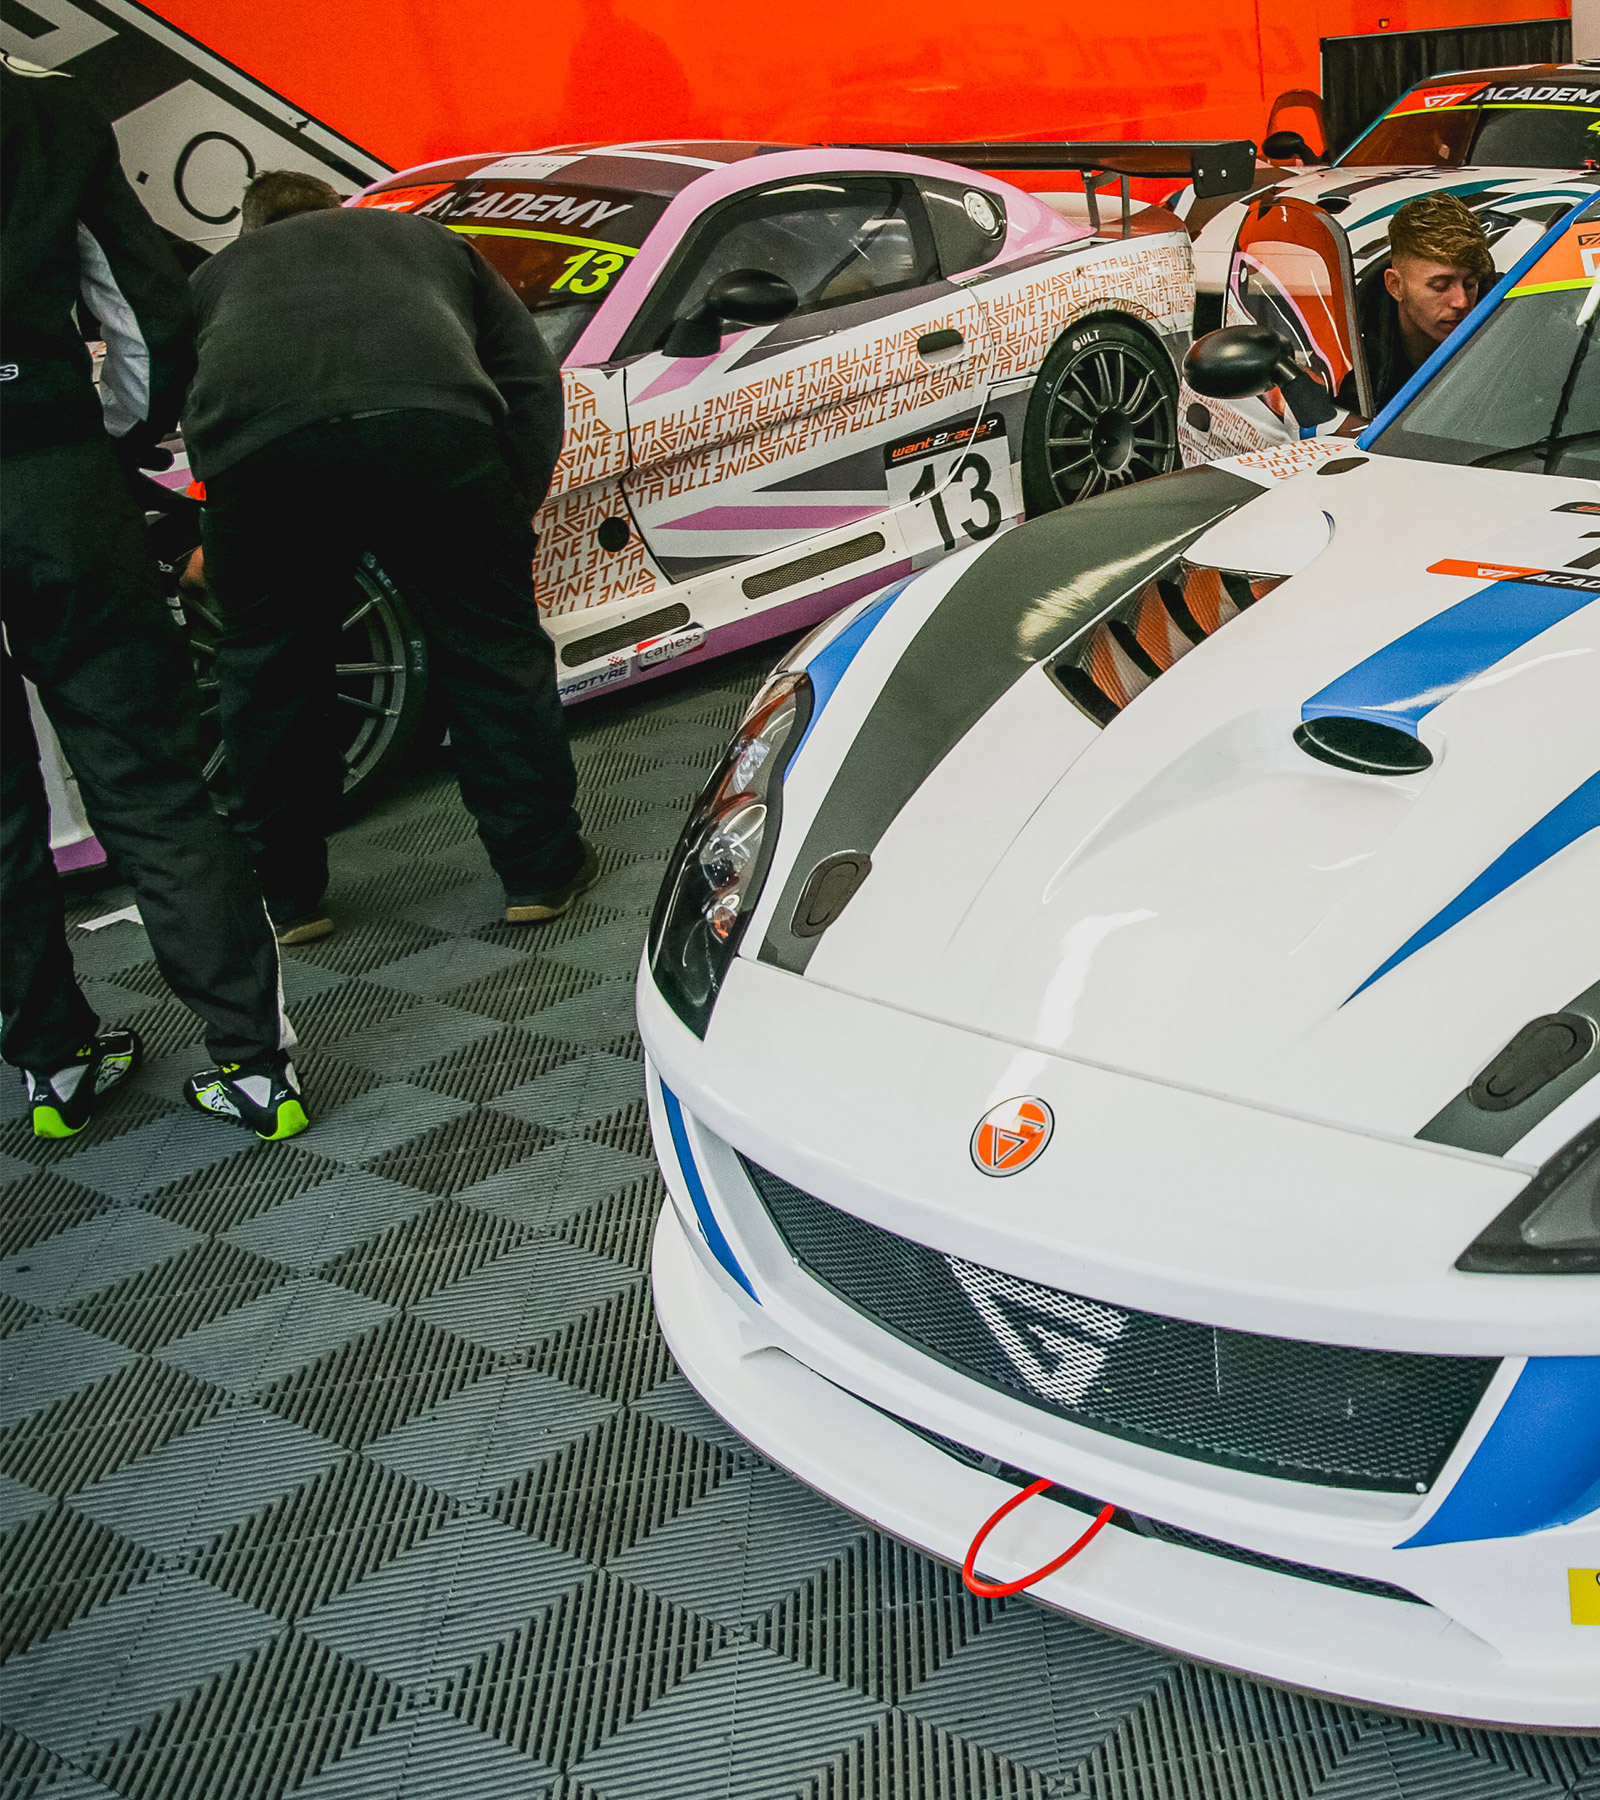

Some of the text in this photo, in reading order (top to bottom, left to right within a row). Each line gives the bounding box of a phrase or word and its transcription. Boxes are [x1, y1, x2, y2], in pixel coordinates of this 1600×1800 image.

[1424, 92, 1467, 108] GT
[551, 249, 624, 295] 13
[746, 357, 833, 399] GINETTA
[758, 419, 847, 463] GINETTA
[909, 452, 1002, 551] 13
[644, 632, 701, 659] carless
